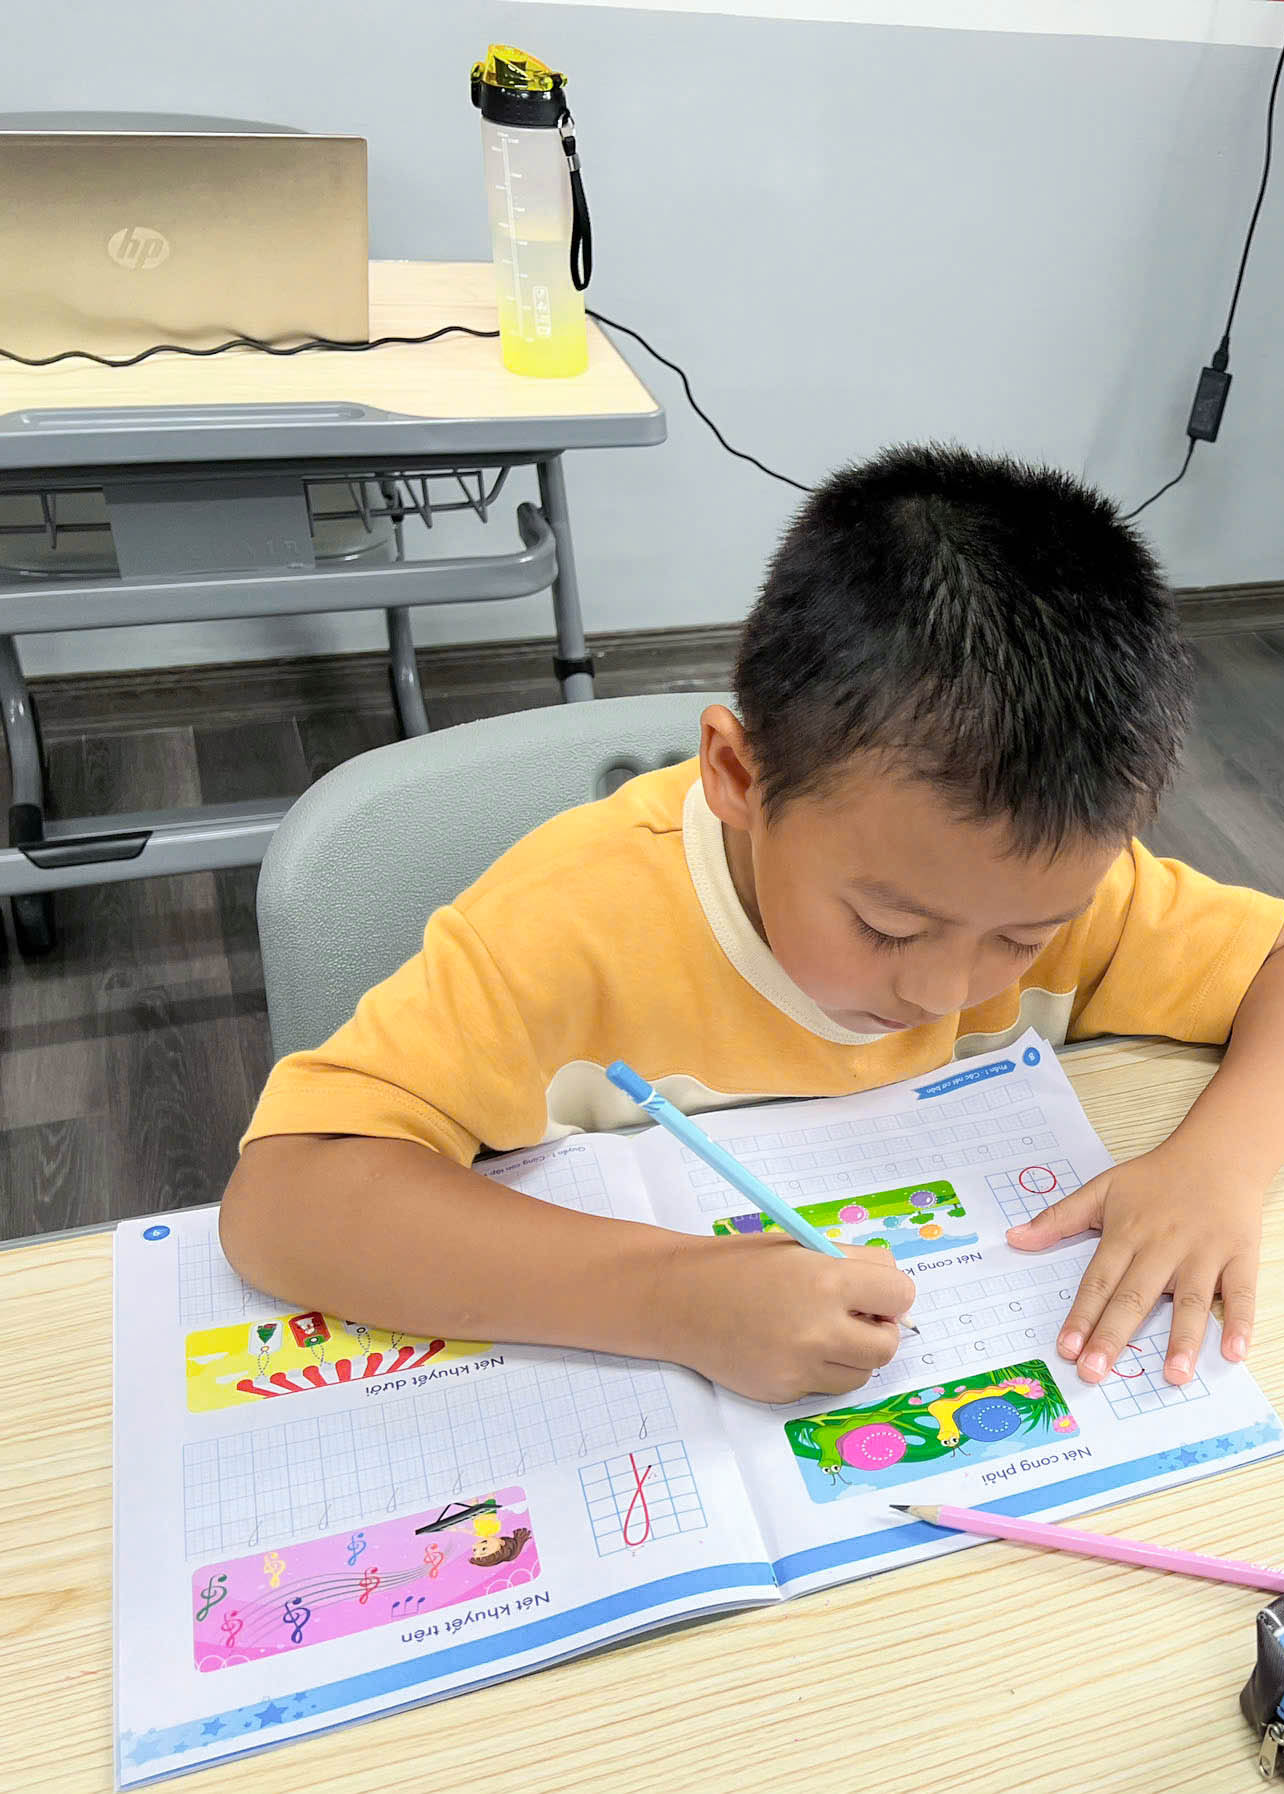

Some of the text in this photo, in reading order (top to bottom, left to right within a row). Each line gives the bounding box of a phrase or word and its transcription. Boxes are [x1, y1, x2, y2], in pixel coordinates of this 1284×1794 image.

[112, 226, 168, 271] hp
[917, 1259, 953, 1272] cong
[956, 1252, 983, 1264] Nét
[365, 1355, 505, 1397] Nét khuyết dưới
[981, 1446, 1092, 1486] Nét cong phải
[400, 1591, 550, 1644] Nét khuyết trên
